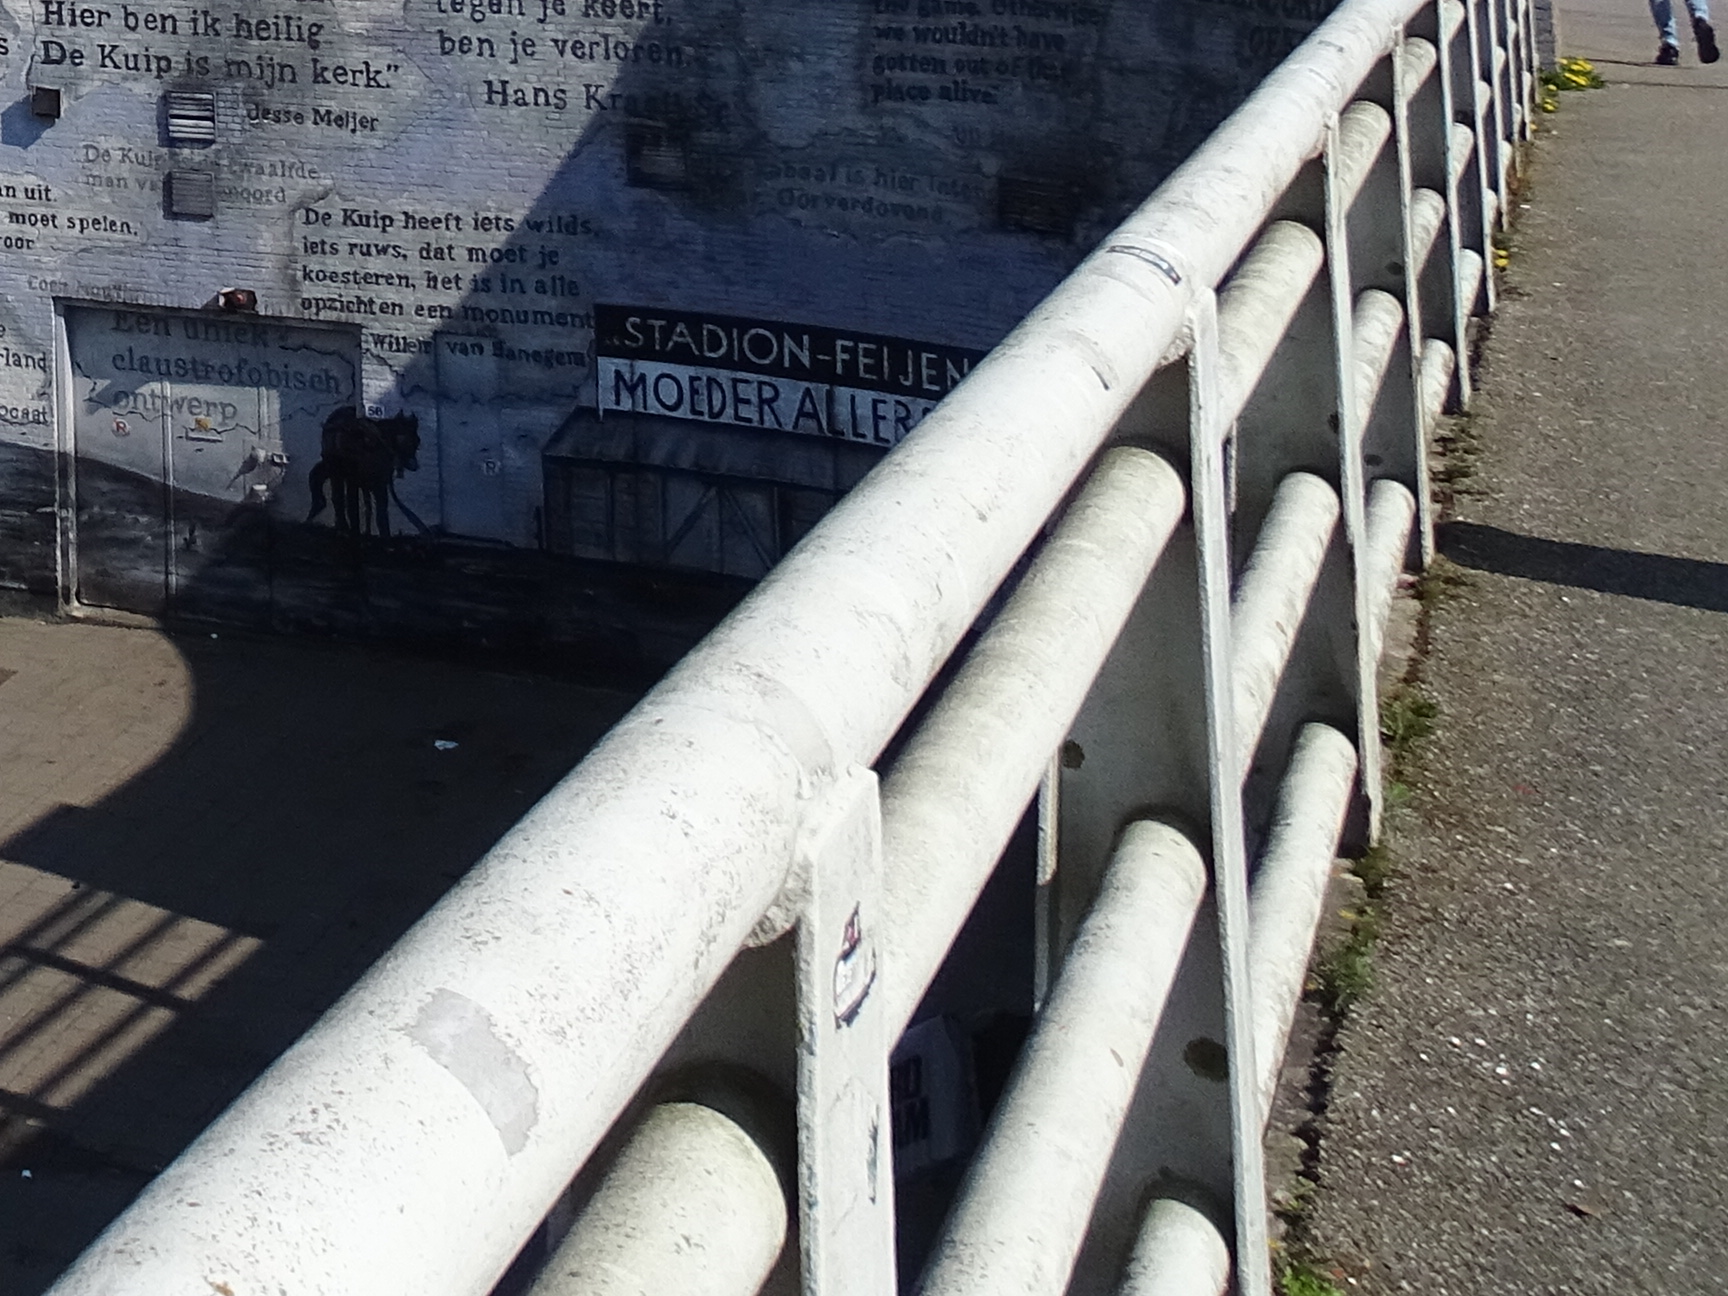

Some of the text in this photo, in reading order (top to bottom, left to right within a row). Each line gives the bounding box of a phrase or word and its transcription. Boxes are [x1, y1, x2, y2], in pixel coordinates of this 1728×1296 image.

[40, 0, 111, 28] Hier
[123, 4, 178, 36] ben
[189, 10, 221, 38] ik
[438, 29, 536, 64] ben je
[40, 40, 84, 66] De
[97, 43, 172, 79] Kuip
[186, 51, 210, 76] is
[225, 56, 298, 89] mijn
[483, 80, 567, 110] Hans
[82, 143, 112, 164] De
[84, 172, 128, 190] man
[8, 212, 58, 230] moet
[67, 215, 139, 236] spelen.
[302, 207, 332, 226] De
[342, 209, 394, 234] Kuip
[402, 210, 463, 232] heeft
[472, 211, 515, 232] iets
[303, 236, 339, 256] iets
[419, 241, 456, 261] dat
[467, 244, 528, 265] moet
[537, 247, 560, 270] je
[302, 265, 580, 297] koesteren, het is in alle
[300, 293, 595, 330] opzichten een monument
[445, 340, 485, 356] van
[111, 346, 343, 395] claustrofobisch
[112, 387, 238, 424] ontwerp
[613, 369, 783, 430] MOEDER
